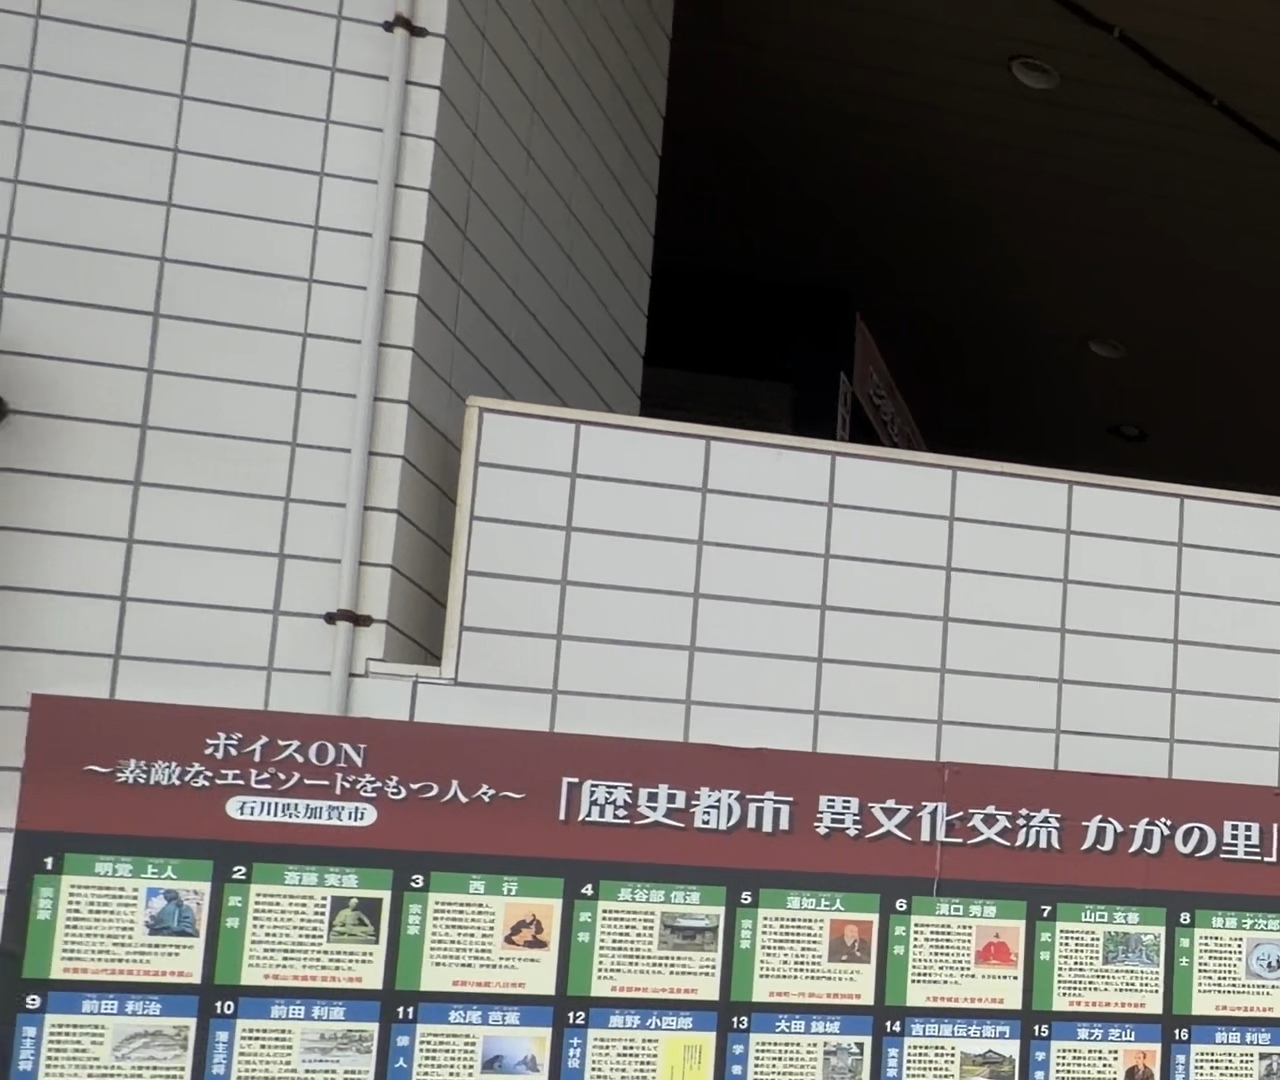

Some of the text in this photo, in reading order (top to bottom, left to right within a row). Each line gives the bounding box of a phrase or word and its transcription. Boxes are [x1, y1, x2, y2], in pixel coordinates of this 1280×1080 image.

[204, 731, 368, 767] ボイスON
[236, 800, 368, 823] 石川県加賀市
[559, 777, 1279, 861] 「歴史都市 異文化交流 かがの里」
[44, 857, 53, 870] 1
[95, 862, 177, 879] 明覚 上人
[232, 867, 246, 878] 2
[325, 872, 359, 888] 実盛
[410, 875, 424, 888] 3
[581, 885, 593, 897] 4
[618, 888, 664, 903] 長谷部
[740, 892, 752, 904] 5
[787, 896, 845, 912] 蓮如上人
[896, 899, 908, 911] 6
[935, 902, 997, 918] 溝口 秀勝
[1040, 906, 1052, 918] 7
[1082, 910, 1107, 924] 山口
[1180, 913, 1191, 924] 8
[1212, 916, 1280, 931] 後藤 才次郎
[26, 996, 42, 1009] 9
[81, 1000, 162, 1016] 前田 利治
[214, 1002, 234, 1015] 10
[270, 1005, 346, 1021] 前田 利直
[396, 1006, 414, 1020] 11
[448, 1009, 520, 1025] 松尾 芭蕉
[568, 1011, 585, 1025] 12
[646, 1016, 693, 1029] 小四郎
[732, 1016, 749, 1029] 13
[775, 1019, 840, 1035] 大田 錦城
[885, 1021, 901, 1033] 14
[911, 1024, 1010, 1038] 吉田屋伝右衛門
[1033, 1025, 1049, 1037] 15
[1076, 1028, 1135, 1042] 東方 芝山
[1174, 1028, 1189, 1040] 16
[1215, 1031, 1240, 1044] 前田
